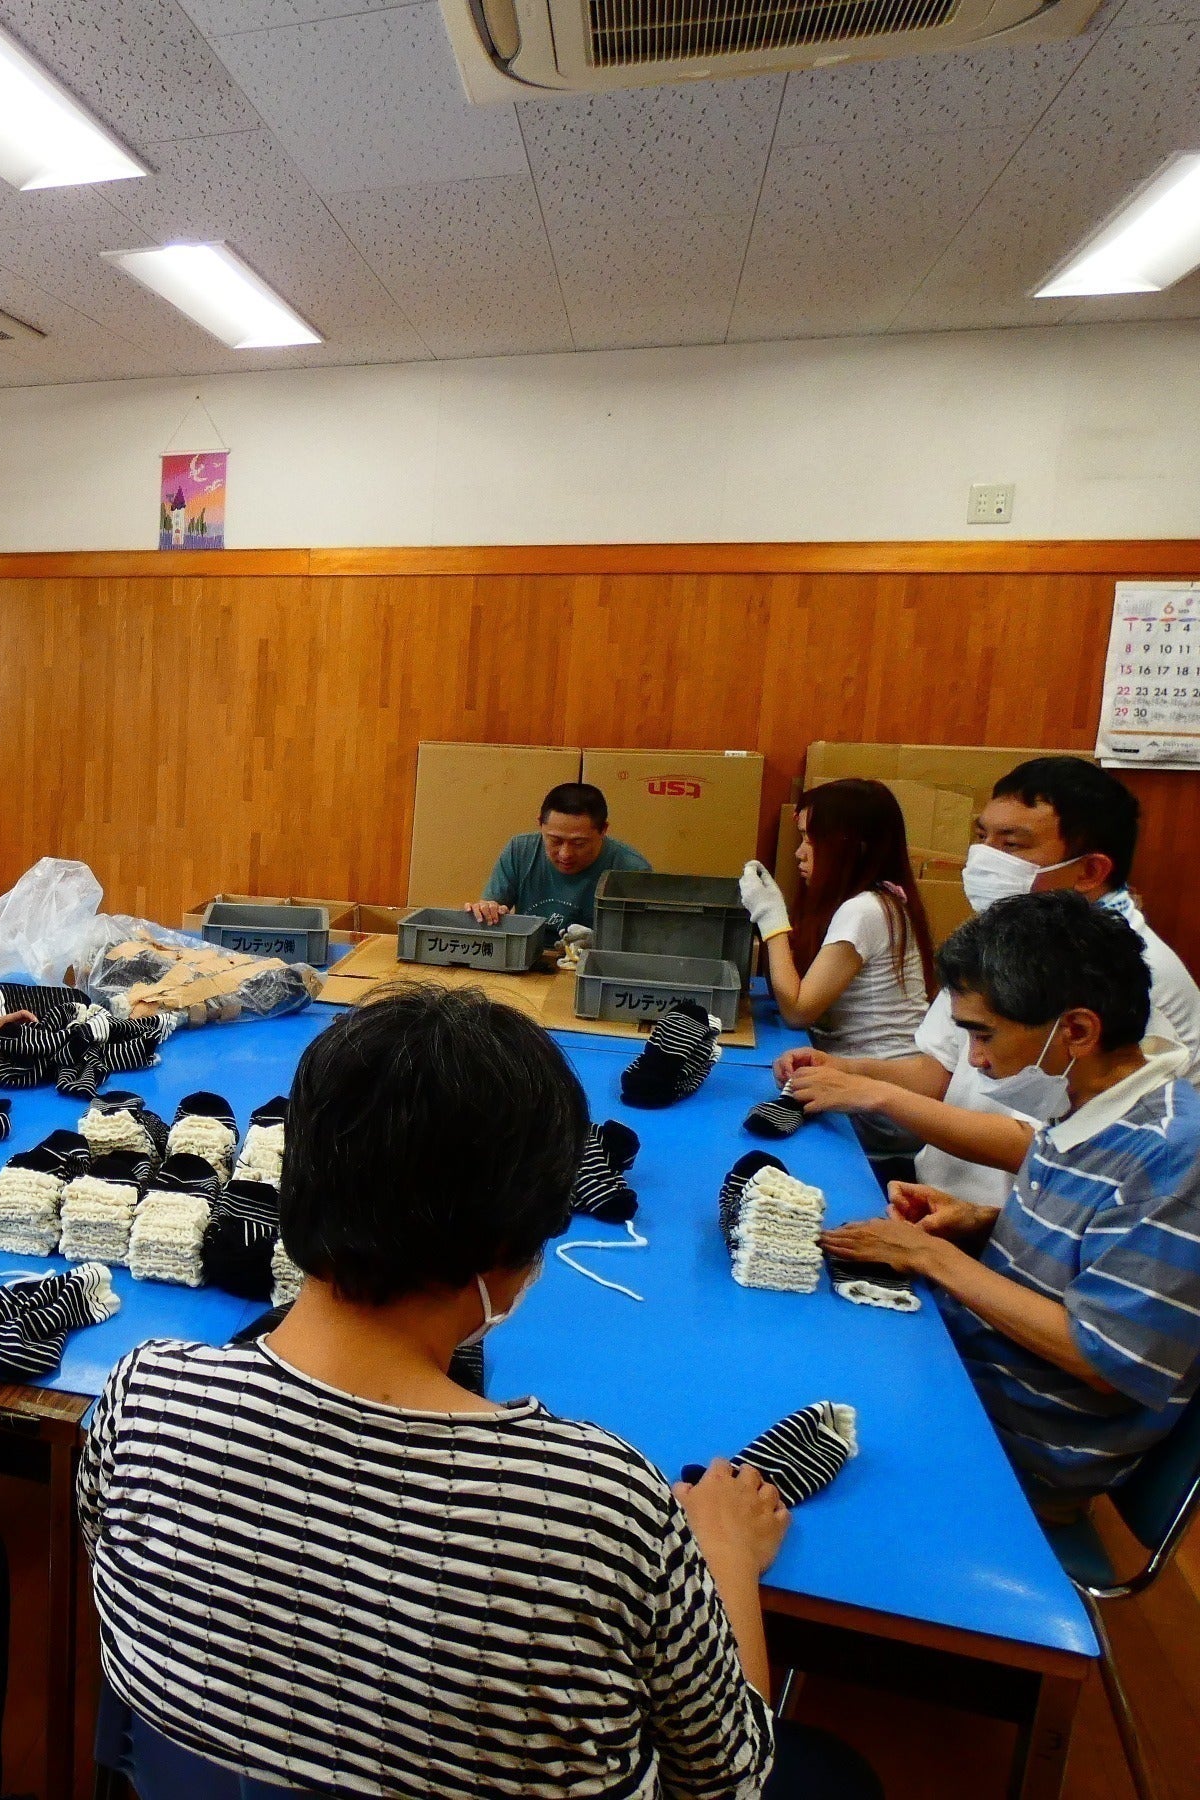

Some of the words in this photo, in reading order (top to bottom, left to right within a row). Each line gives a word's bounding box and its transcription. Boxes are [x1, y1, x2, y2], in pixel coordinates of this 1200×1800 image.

[1163, 601, 1174, 615] 6
[1145, 622, 1153, 632] 2
[1164, 623, 1171, 632] 3
[1182, 623, 1191, 633] 4
[1125, 643, 1132, 654] 8
[1143, 644, 1150, 654] 9
[1159, 644, 1173, 654] 10
[1179, 644, 1191, 654] 11
[1119, 664, 1132, 675] 15
[1138, 665, 1151, 675] 16
[1157, 665, 1170, 675] 17
[1176, 666, 1189, 676] 18
[1116, 686, 1130, 696] 22
[1135, 686, 1149, 696] 23
[1154, 687, 1168, 697] 24
[1173, 688, 1187, 697] 25
[1114, 707, 1129, 717] 29
[1133, 708, 1147, 718] 30
